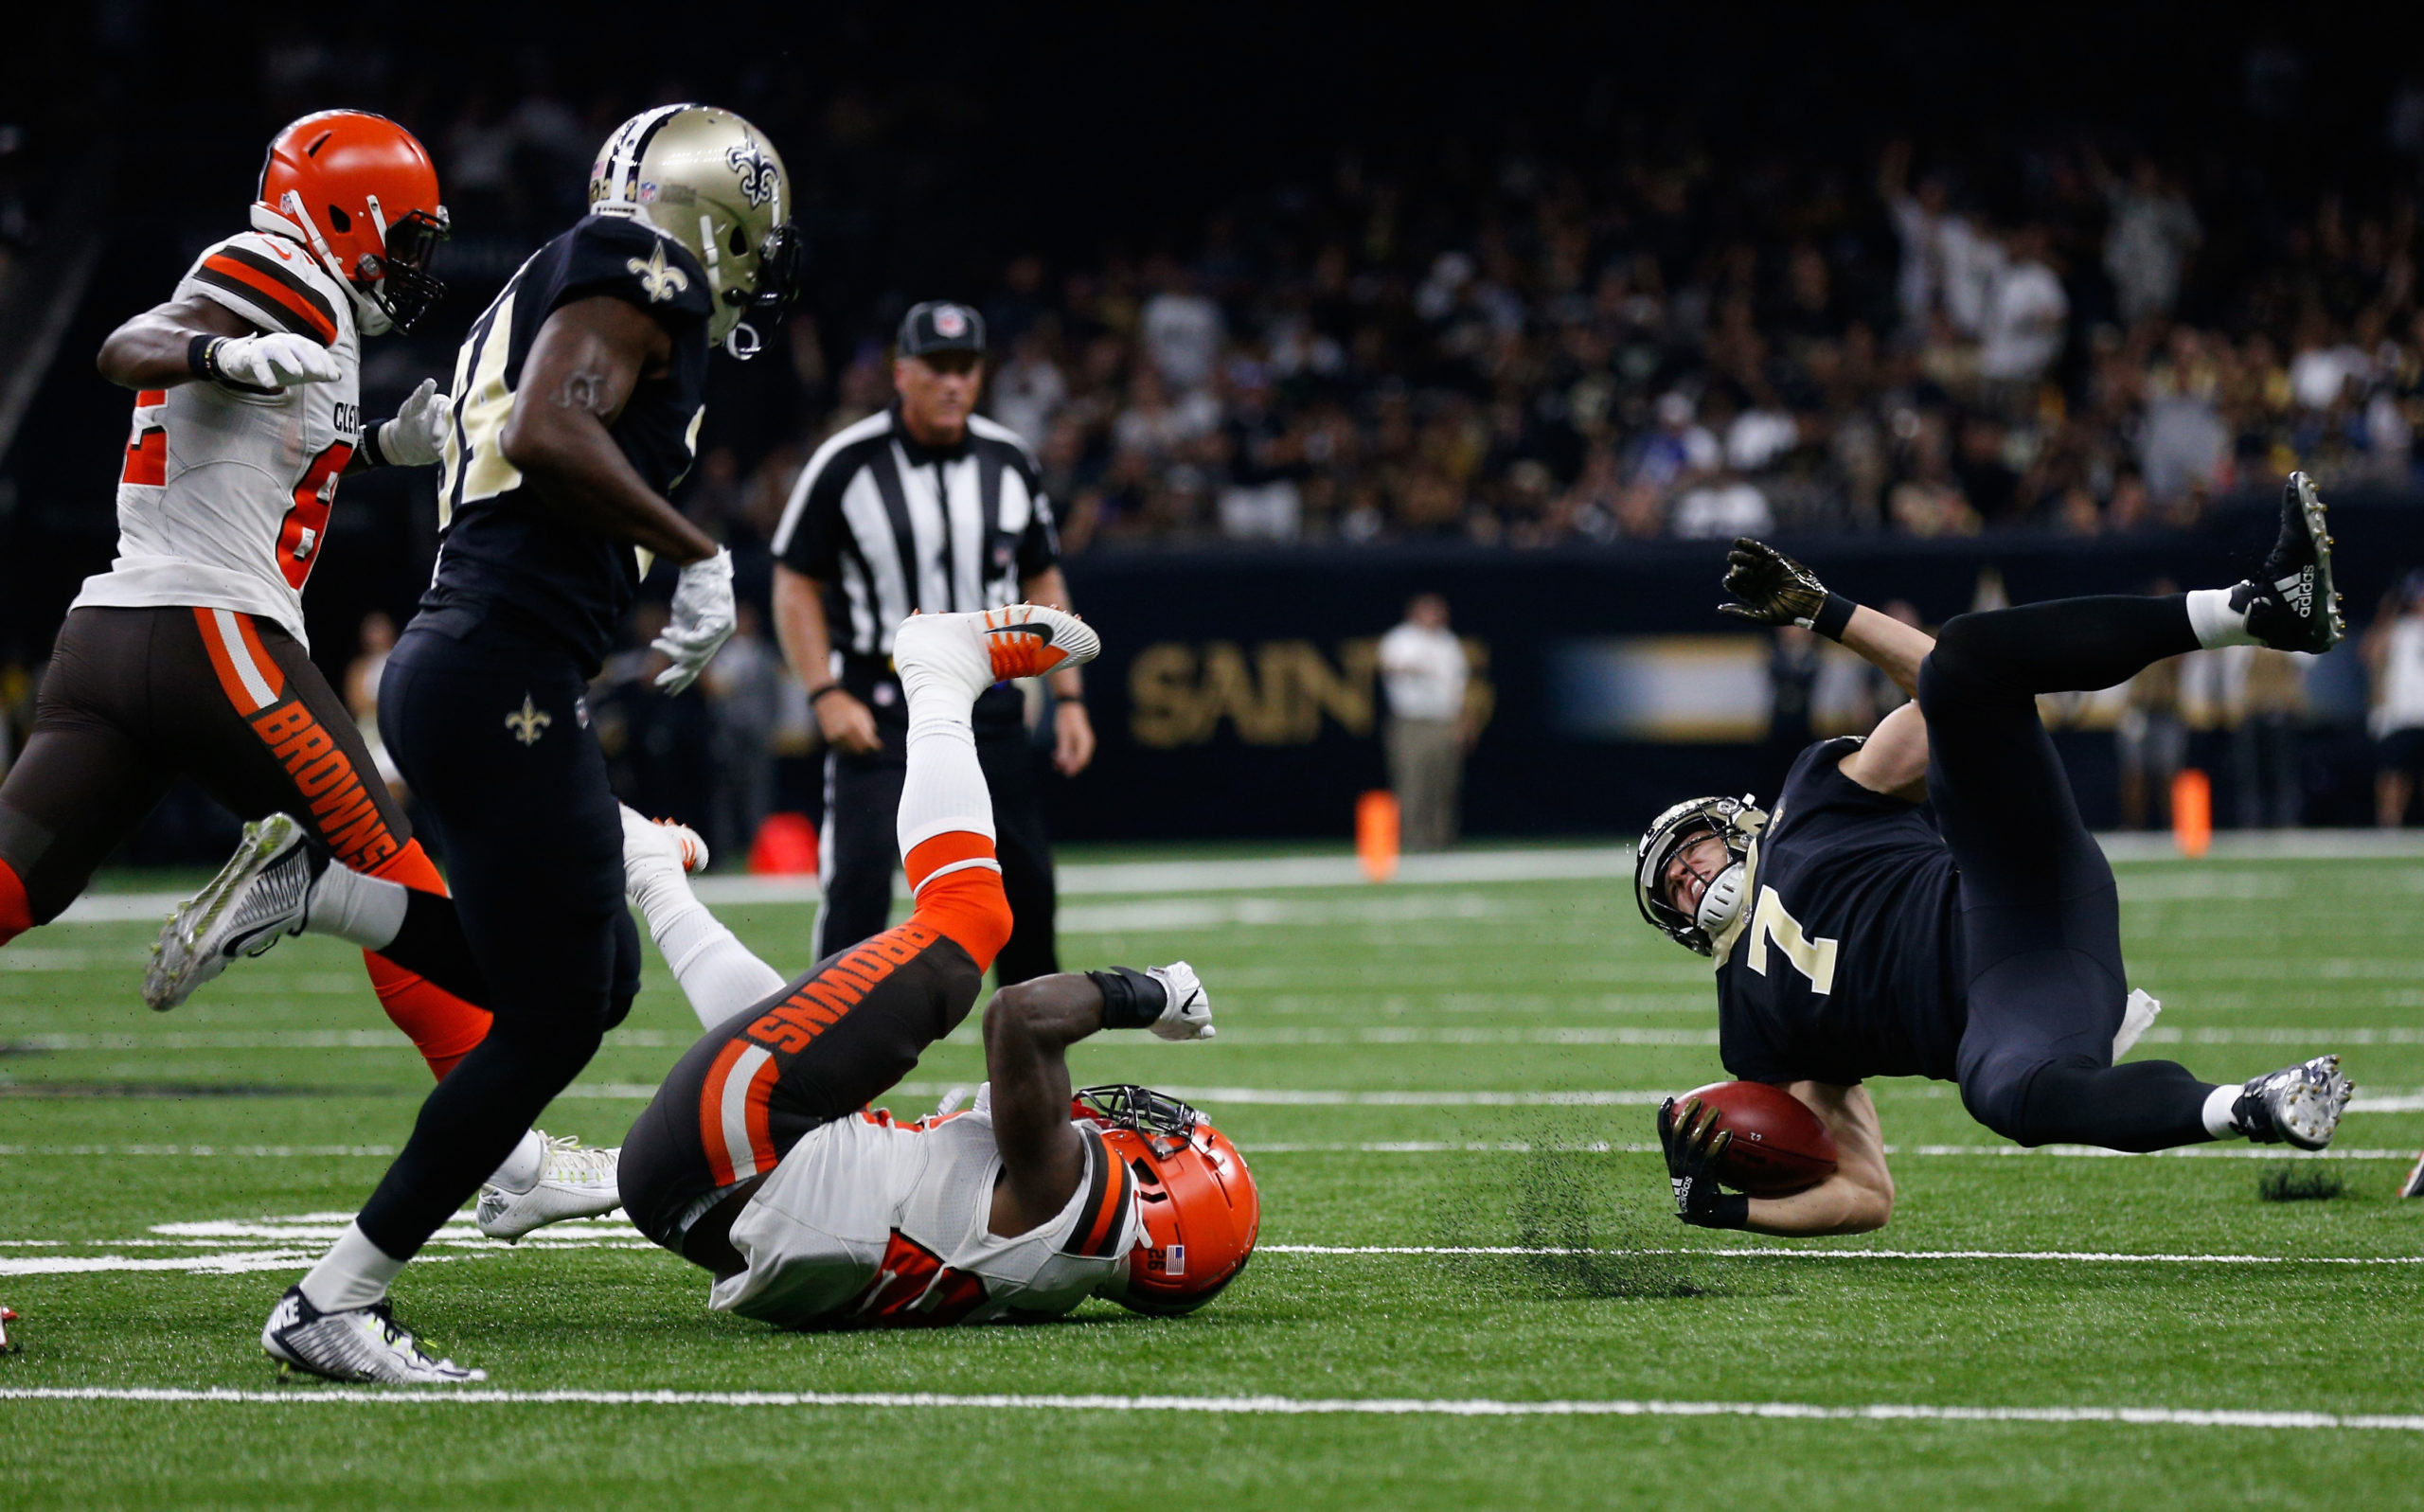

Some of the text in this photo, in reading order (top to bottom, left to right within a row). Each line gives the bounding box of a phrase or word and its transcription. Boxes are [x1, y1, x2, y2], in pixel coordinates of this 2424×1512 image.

[2298, 564, 2315, 618] adidas
[251, 700, 400, 875] BROWNS
[746, 920, 942, 1055] BROWNS
[1747, 883, 1838, 995] 7
[1148, 1248, 1167, 1272] 26
